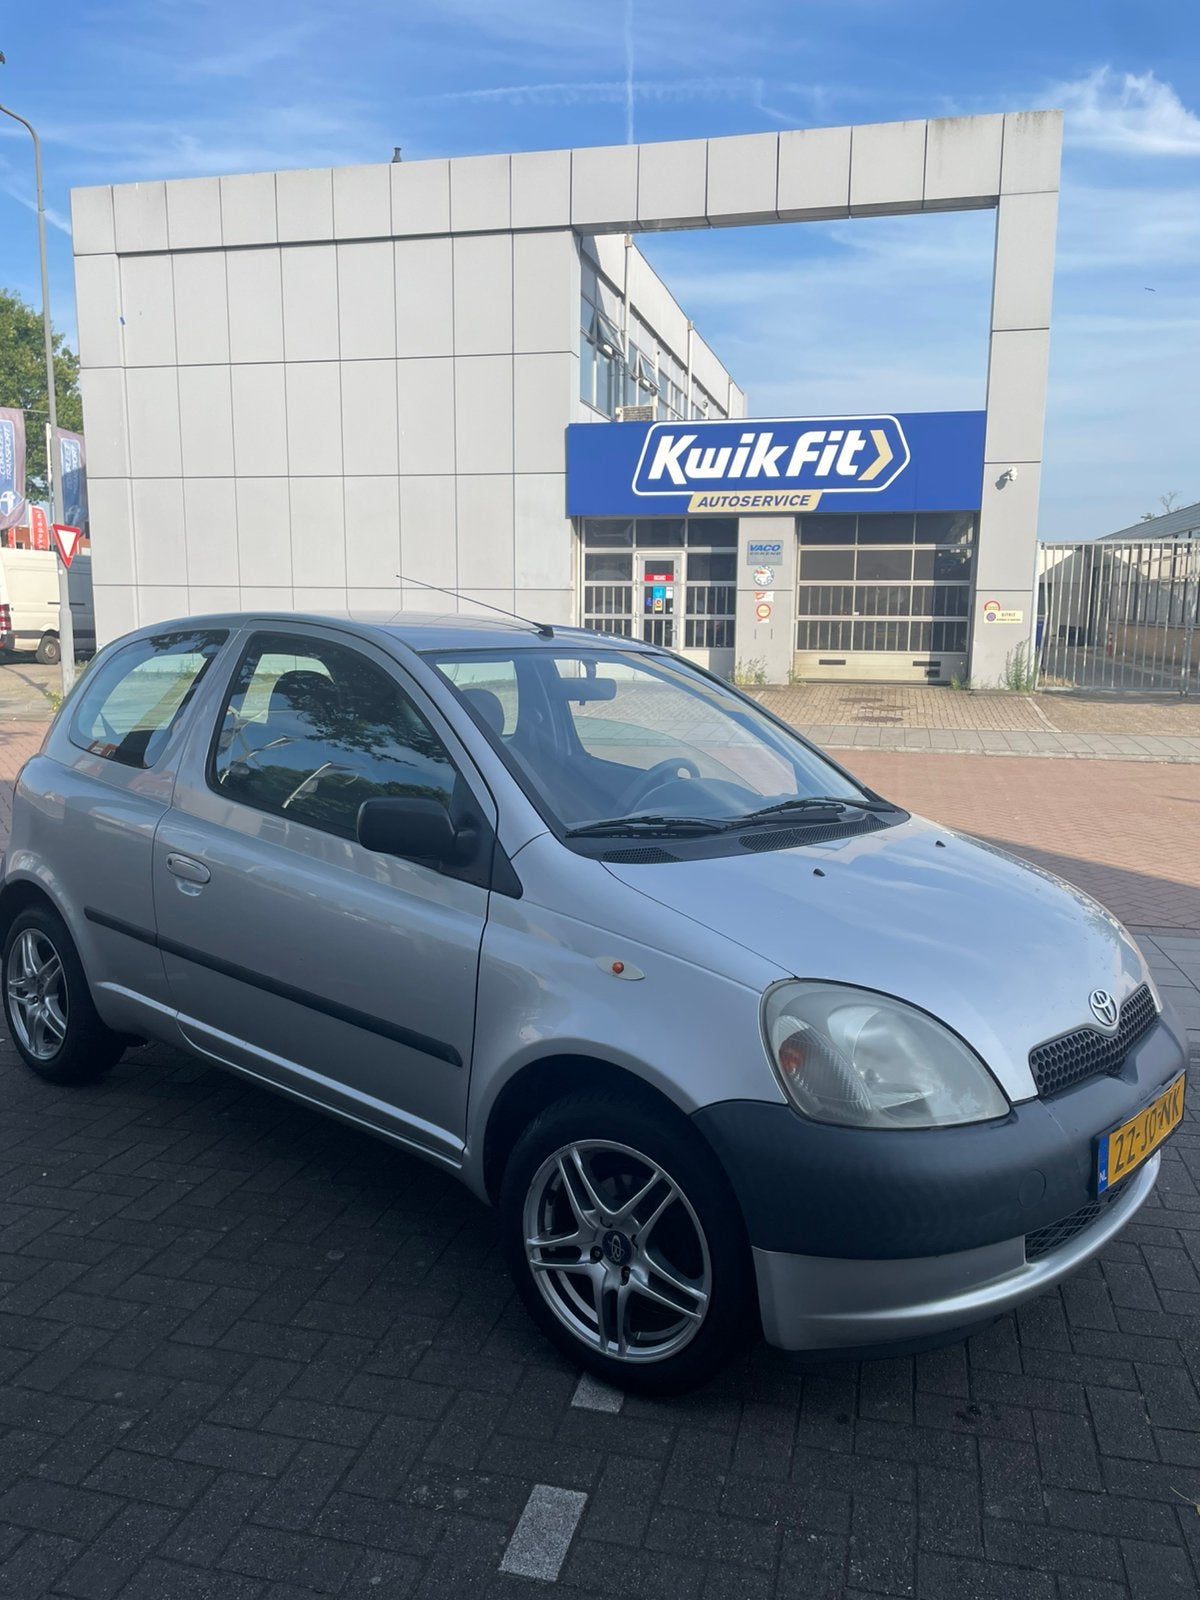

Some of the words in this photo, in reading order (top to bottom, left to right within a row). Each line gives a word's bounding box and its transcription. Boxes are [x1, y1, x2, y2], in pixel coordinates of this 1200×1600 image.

[3, 425, 11, 480] TRANSPORT
[697, 494, 812, 507] AUTOSERVICE
[1099, 1169, 1107, 1183] NL
